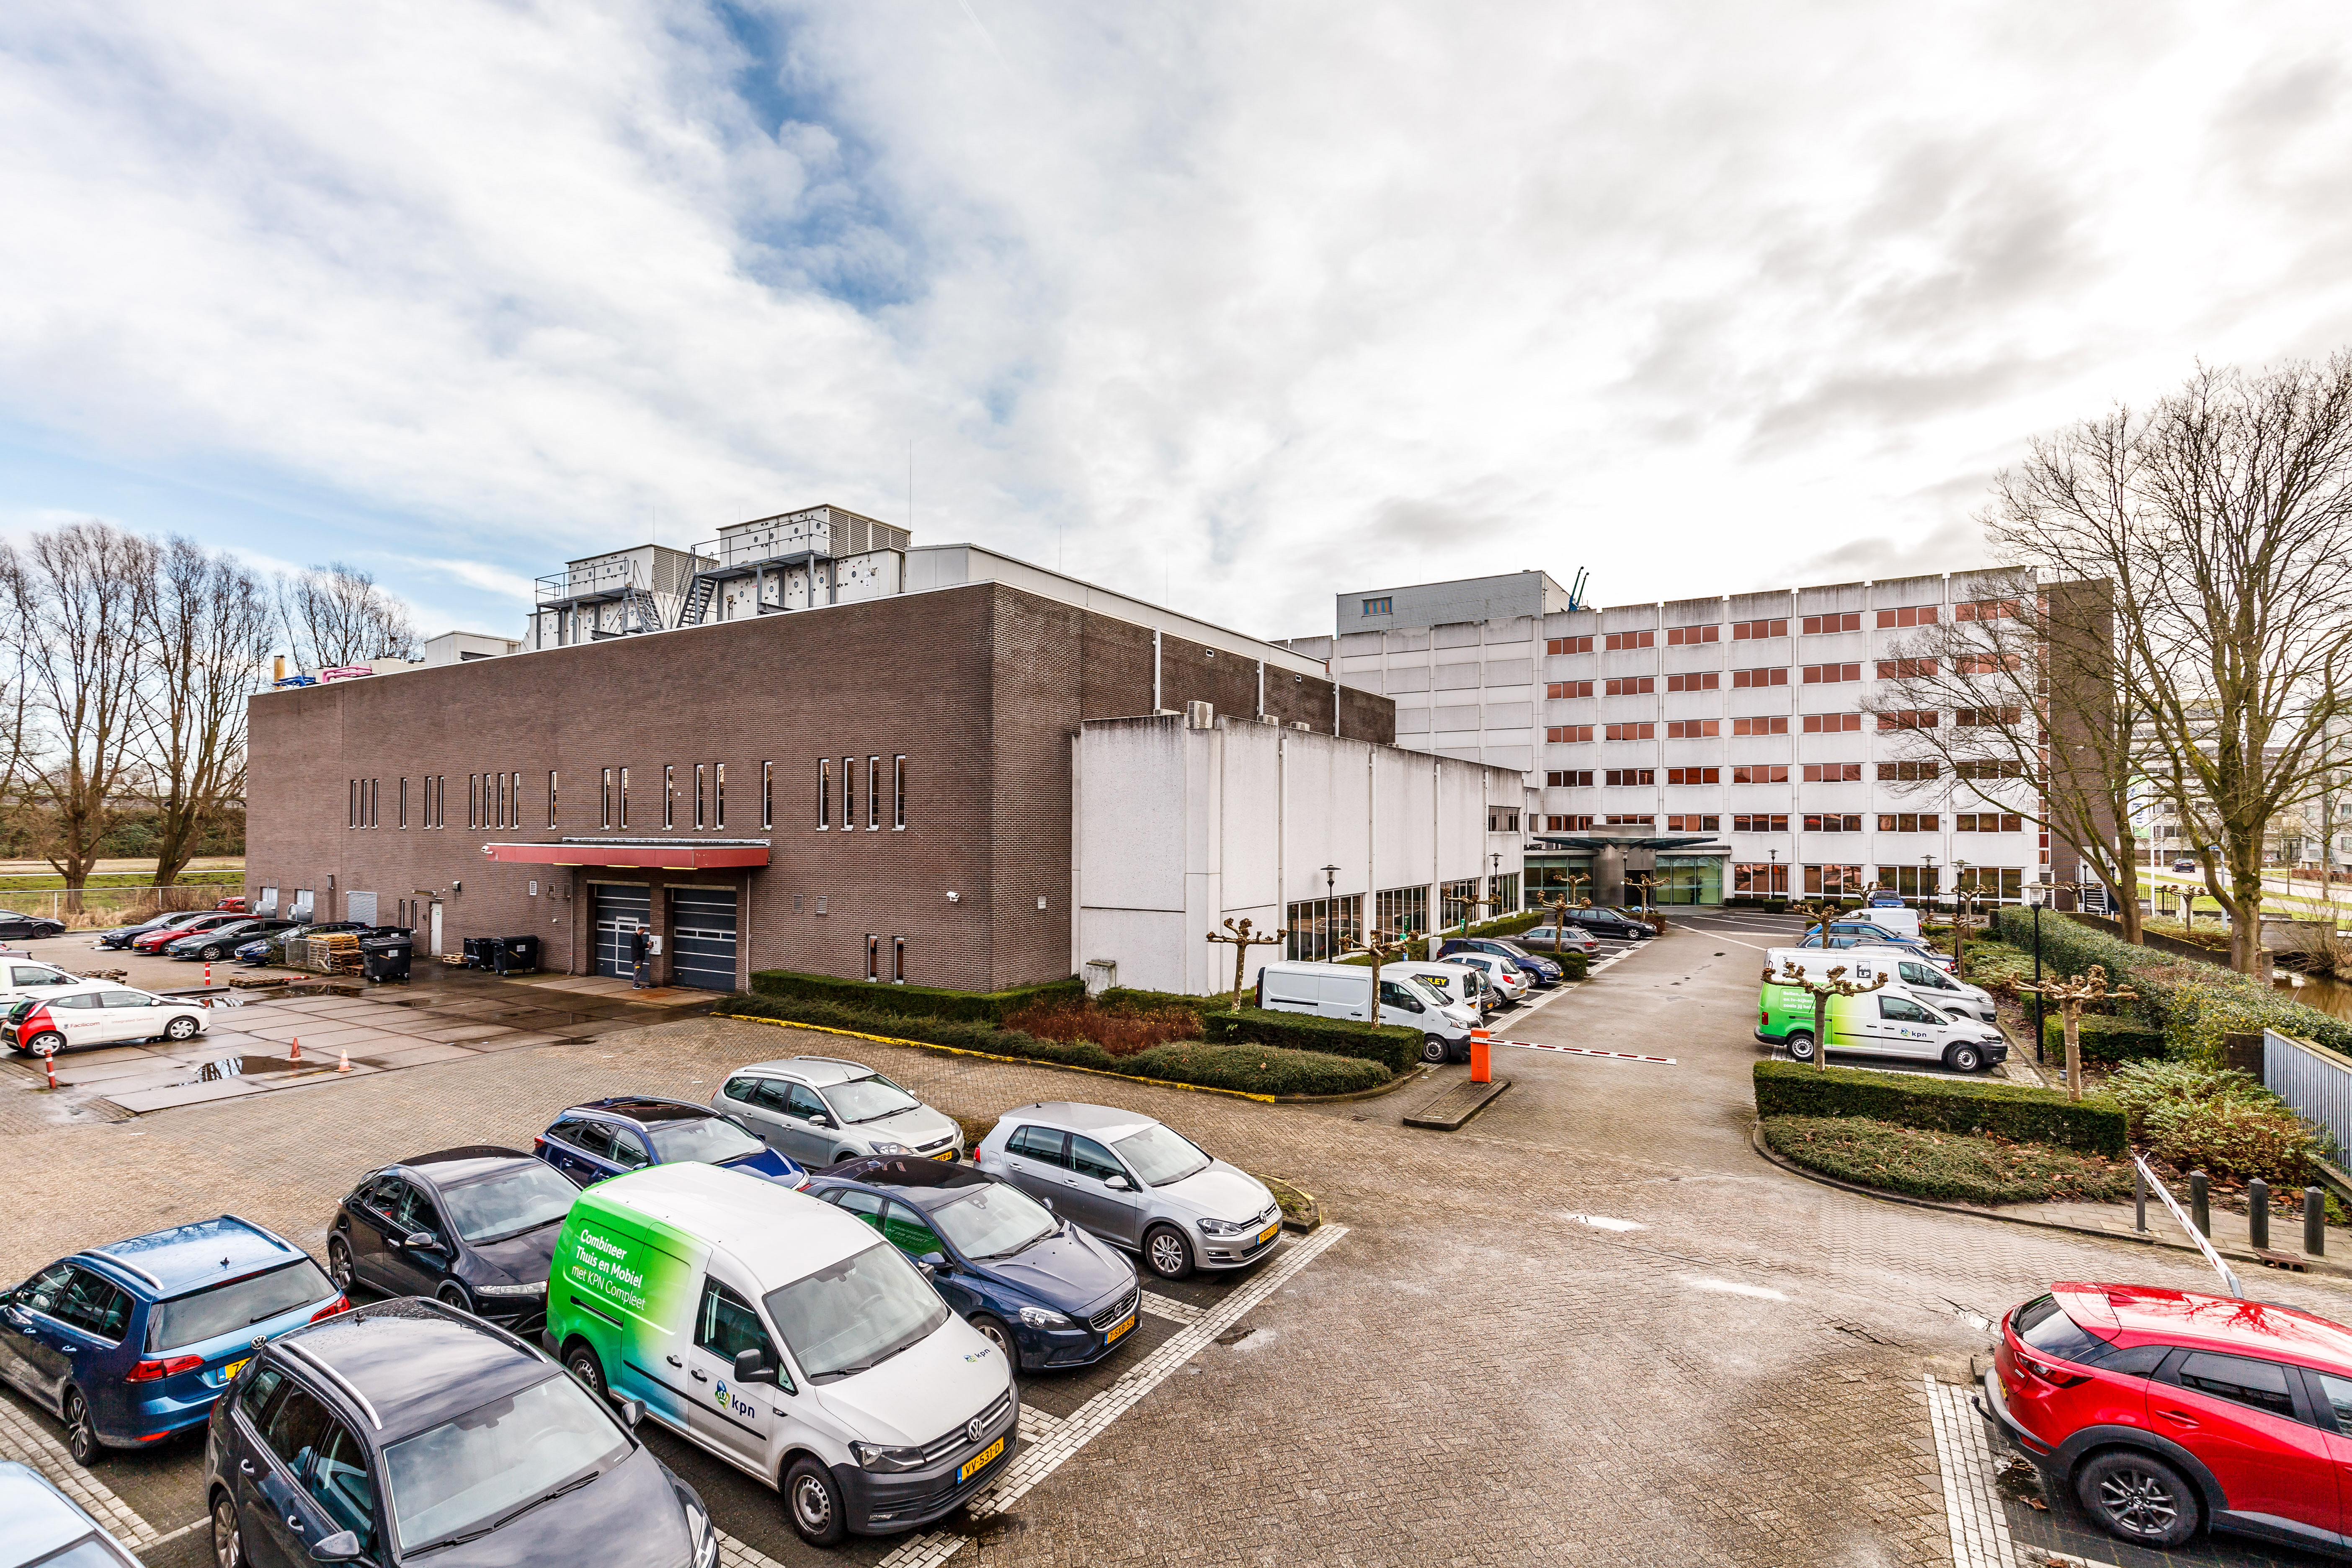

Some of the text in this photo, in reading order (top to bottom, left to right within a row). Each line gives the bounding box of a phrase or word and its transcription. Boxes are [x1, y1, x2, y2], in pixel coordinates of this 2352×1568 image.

[580, 1229, 627, 1260] Combineer
[576, 1246, 643, 1289] Thuis en Mobiel
[571, 1266, 646, 1310] met KPN Compleet
[1109, 1318, 1134, 1341] 7-SXB-52
[974, 1349, 991, 1358] kpn
[732, 1394, 755, 1419] kpn
[965, 1443, 1000, 1475] VV-531-D
